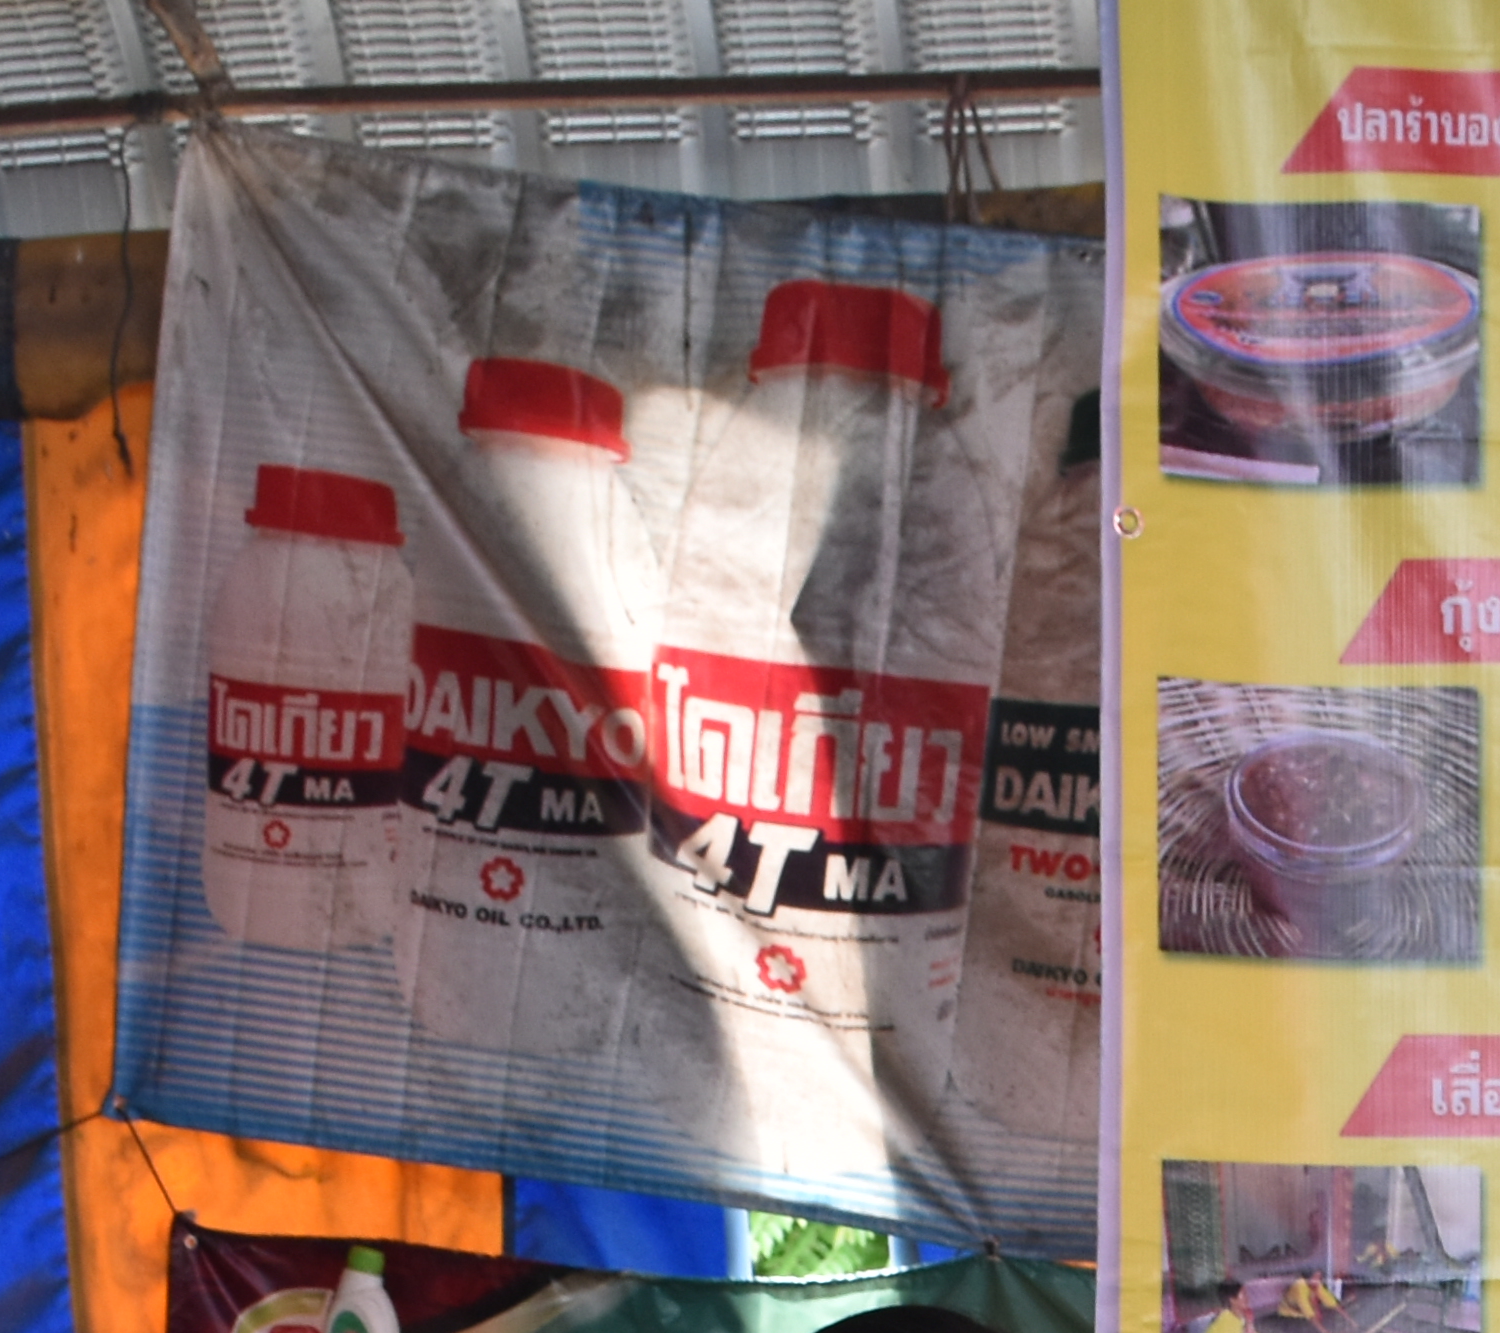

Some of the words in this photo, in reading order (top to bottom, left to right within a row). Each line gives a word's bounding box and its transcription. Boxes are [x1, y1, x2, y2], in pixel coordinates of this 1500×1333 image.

[1002, 721, 1053, 749] LOW
[304, 776, 355, 801] MA
[540, 788, 604, 823] MA
[823, 854, 908, 903] MA
[476, 905, 510, 927] OIL
